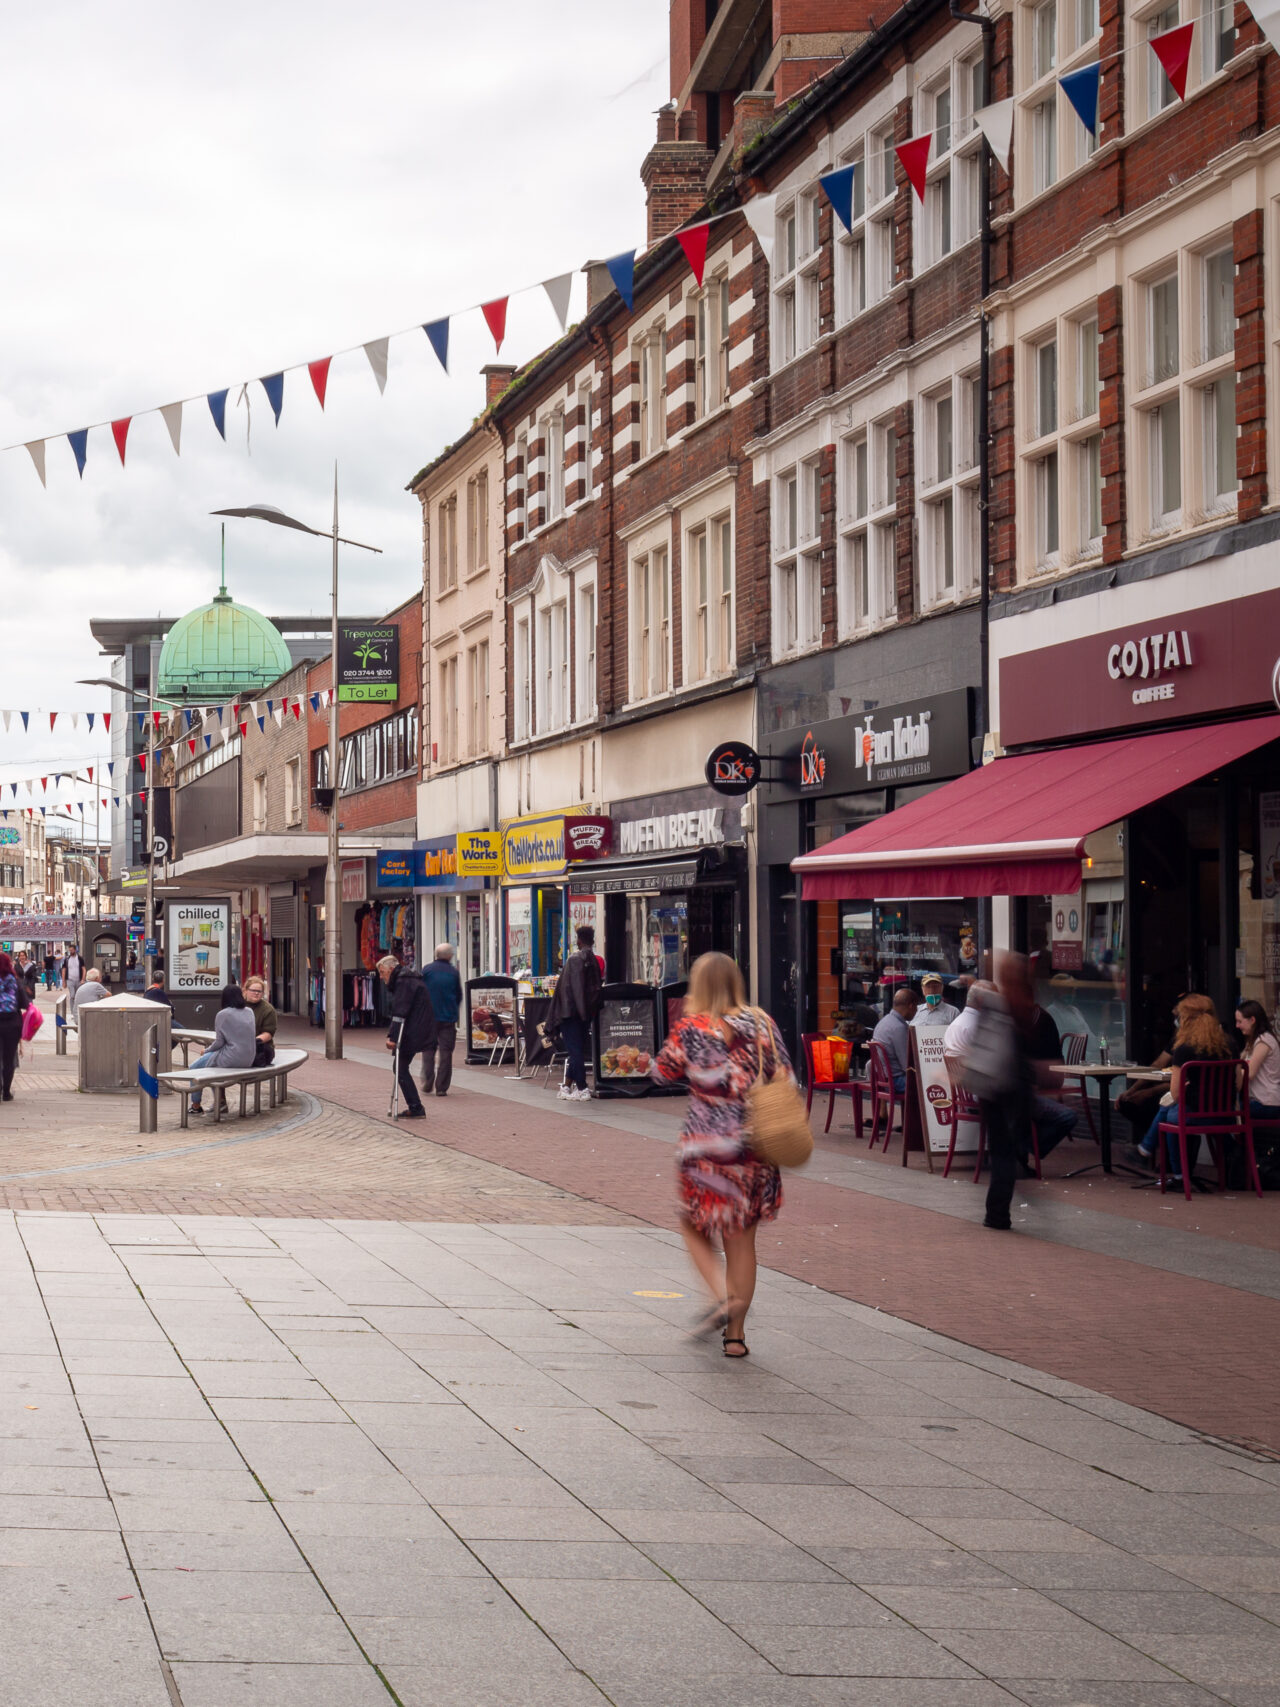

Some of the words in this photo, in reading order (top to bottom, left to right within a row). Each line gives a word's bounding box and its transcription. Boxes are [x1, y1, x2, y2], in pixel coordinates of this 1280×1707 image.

[342, 628, 393, 638] Treewood
[1107, 630, 1192, 680] COSTA
[347, 687, 365, 698] To
[368, 687, 388, 698] Let
[1132, 683, 1175, 705] COFFEE
[573, 826, 601, 834] MUFFIN
[620, 815, 669, 854] MUFFIN
[468, 837, 491, 848] The
[575, 839, 599, 847] BREAK
[461, 848, 498, 860] Works
[386, 860, 406, 868] Card
[425, 848, 441, 877] Card
[380, 867, 411, 876] Factory
[178, 908, 220, 919] chilled
[178, 974, 221, 986] coffee
[921, 1038, 943, 1046] HERE'S
